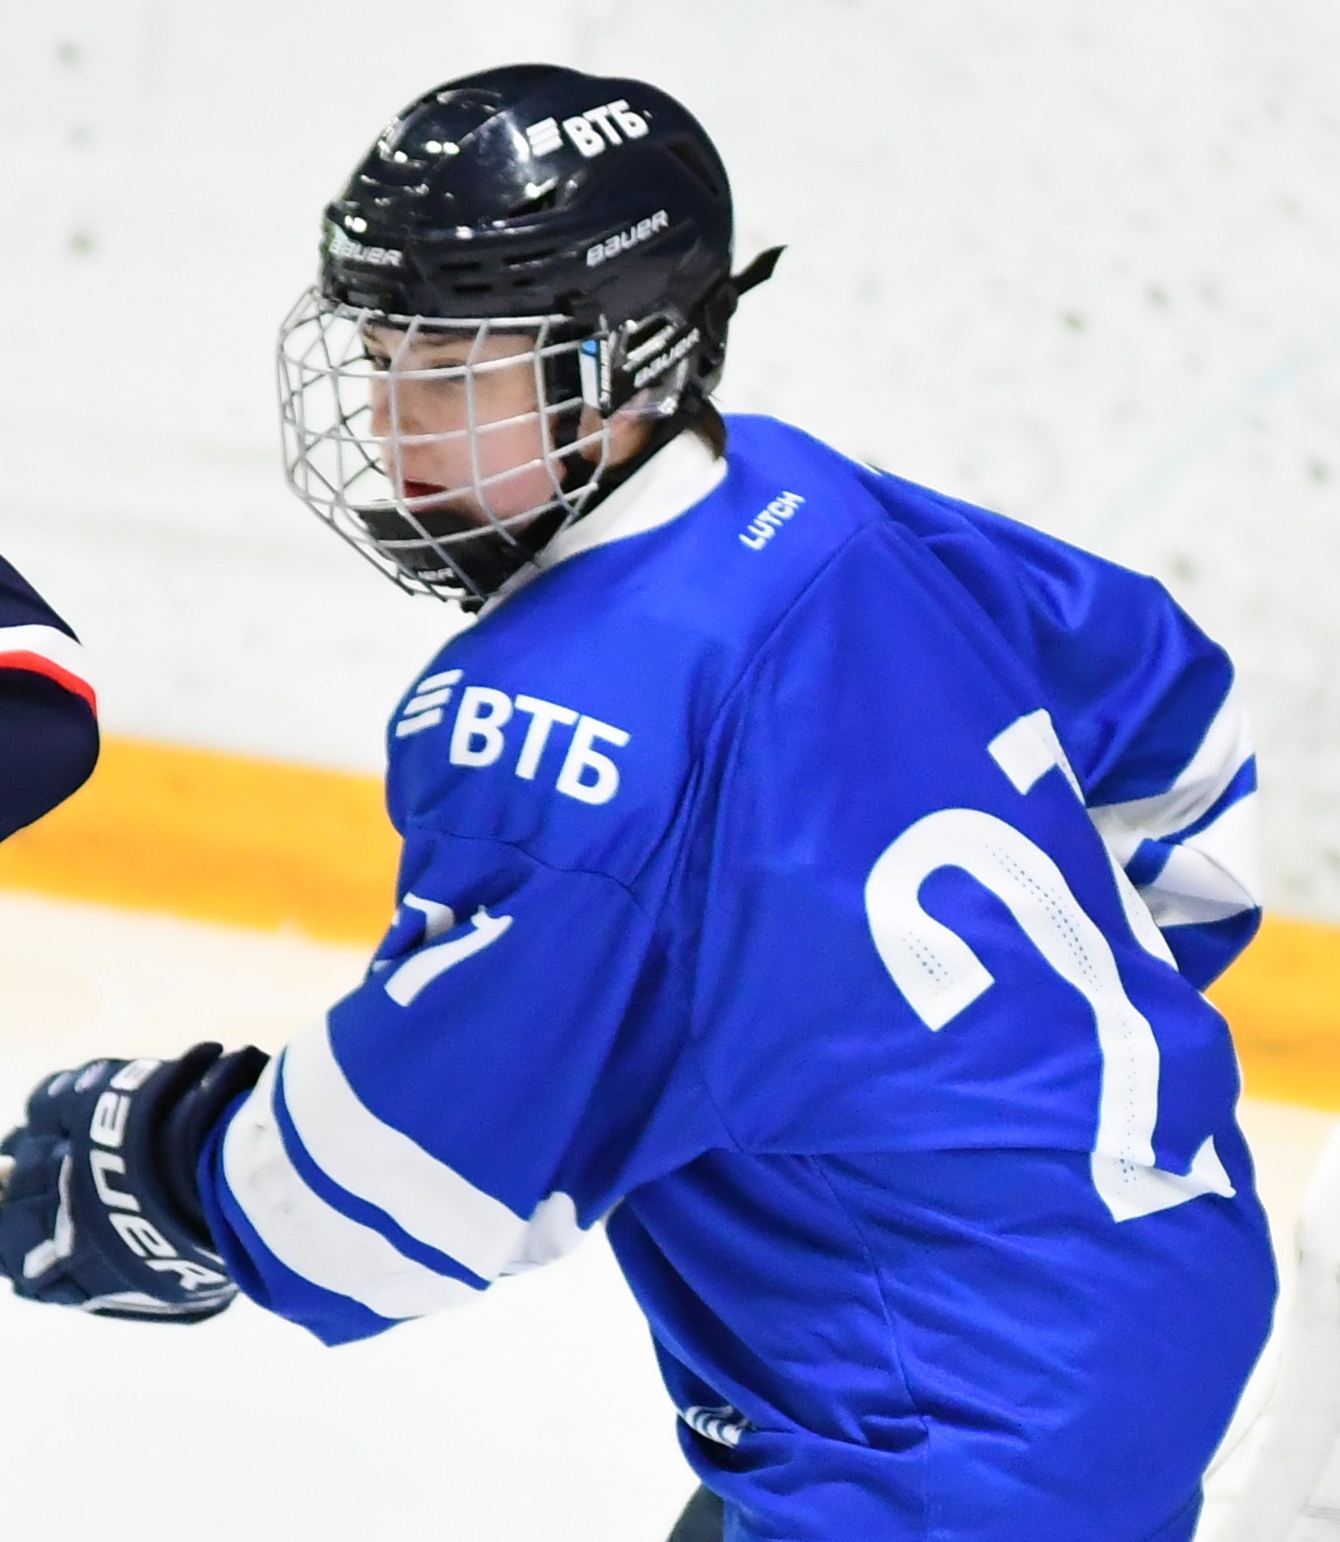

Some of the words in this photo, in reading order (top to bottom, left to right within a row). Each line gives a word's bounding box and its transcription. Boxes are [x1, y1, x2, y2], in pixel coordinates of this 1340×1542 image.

[561, 98, 650, 158] ВТБ
[738, 490, 806, 551] LUTCH
[449, 685, 632, 806] ВТБ
